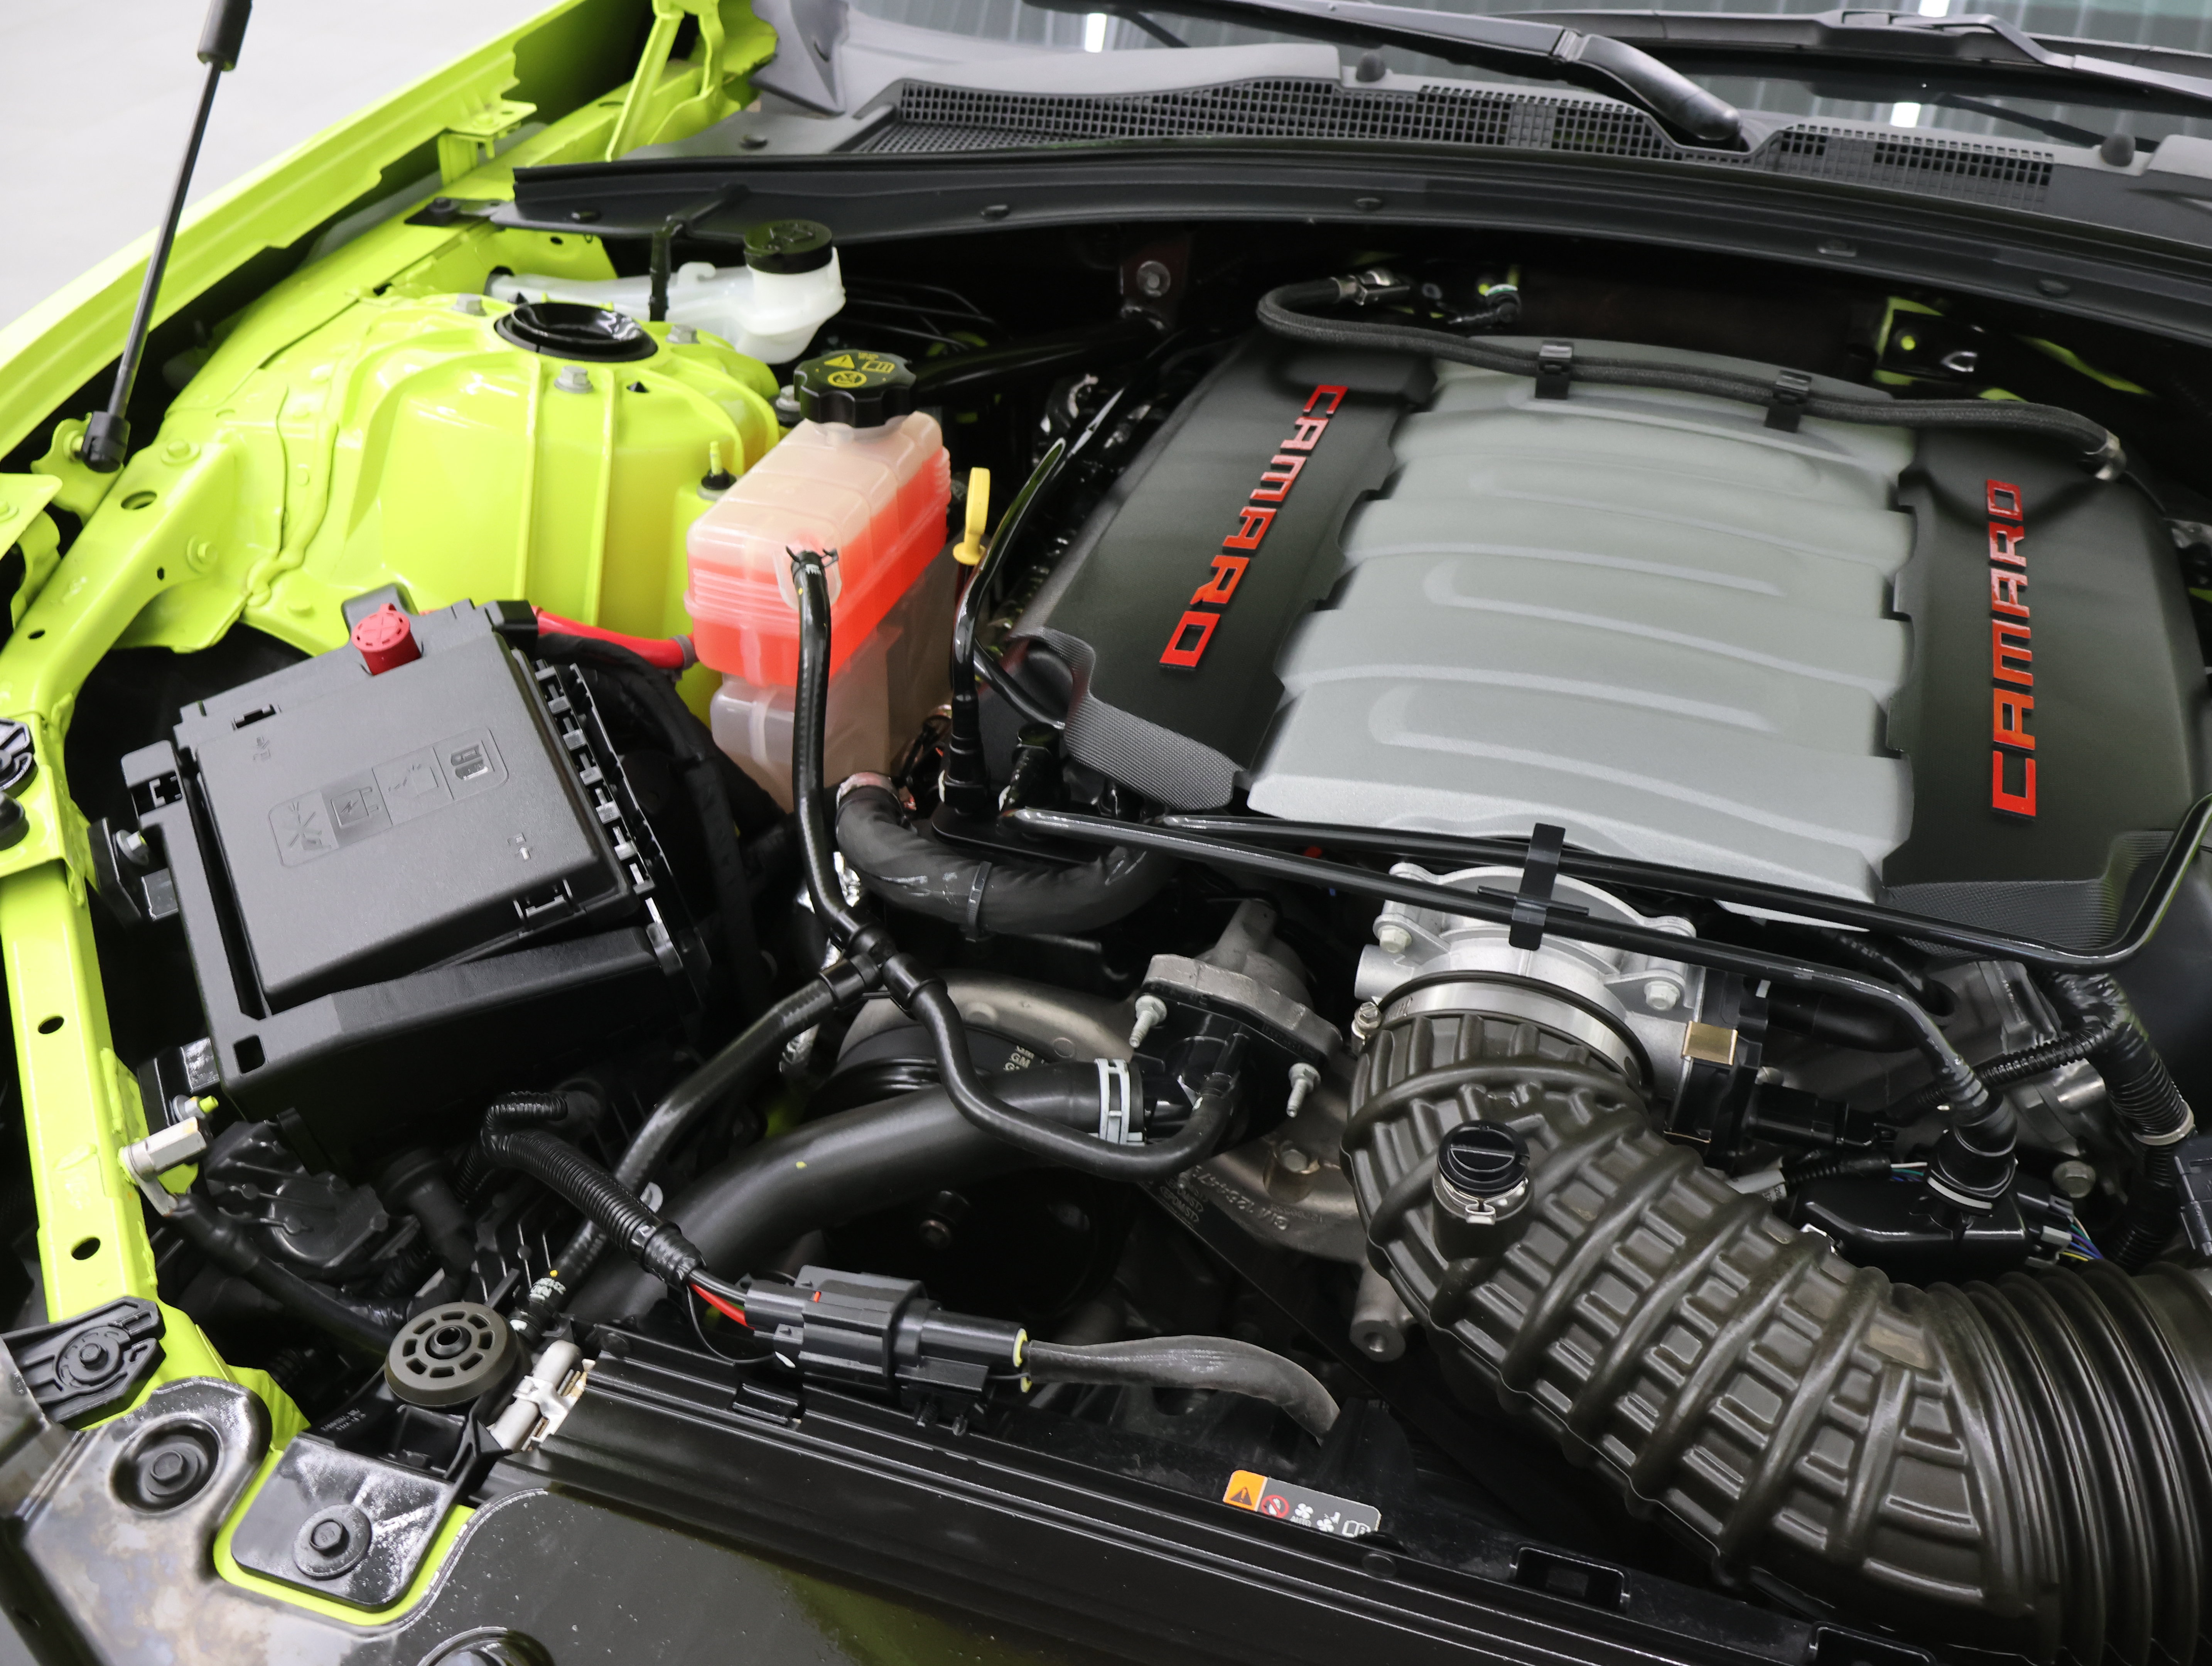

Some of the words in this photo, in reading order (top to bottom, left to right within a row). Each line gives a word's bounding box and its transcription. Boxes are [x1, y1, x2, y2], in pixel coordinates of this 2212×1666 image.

[1159, 385, 1348, 667] CAMARO
[1986, 479, 2036, 816] CAMARO
[1010, 1053, 1031, 1068] GM
[1289, 1516, 1312, 1527] AUTO
